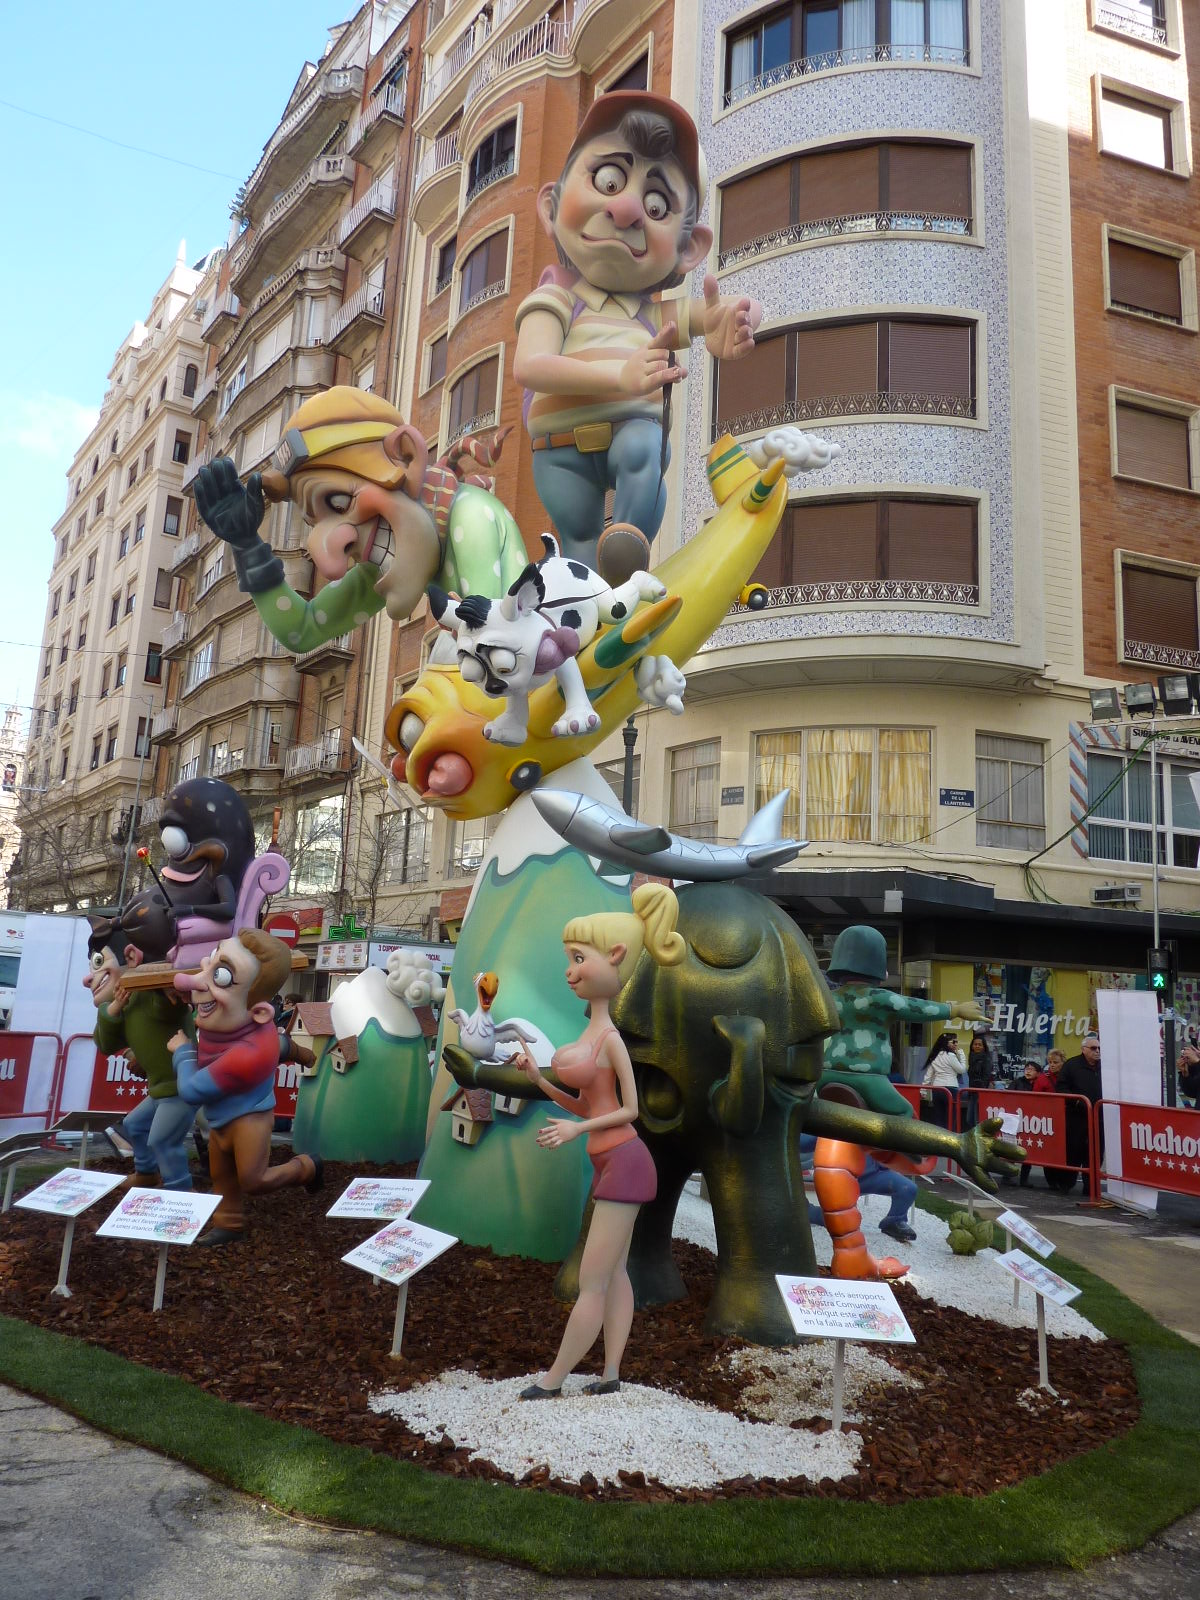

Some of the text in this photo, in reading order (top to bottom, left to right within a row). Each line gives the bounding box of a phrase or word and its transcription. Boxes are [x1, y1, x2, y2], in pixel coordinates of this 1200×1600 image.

[990, 1003, 1091, 1036] Huerta
[791, 1284, 885, 1302] Entre tots els aeroports
[797, 1297, 805, 1306] de
[808, 1298, 835, 1308] Nostra
[800, 1307, 877, 1321] ha volgut este pilot
[803, 1318, 815, 1326] en
[824, 1318, 843, 1328] falla
